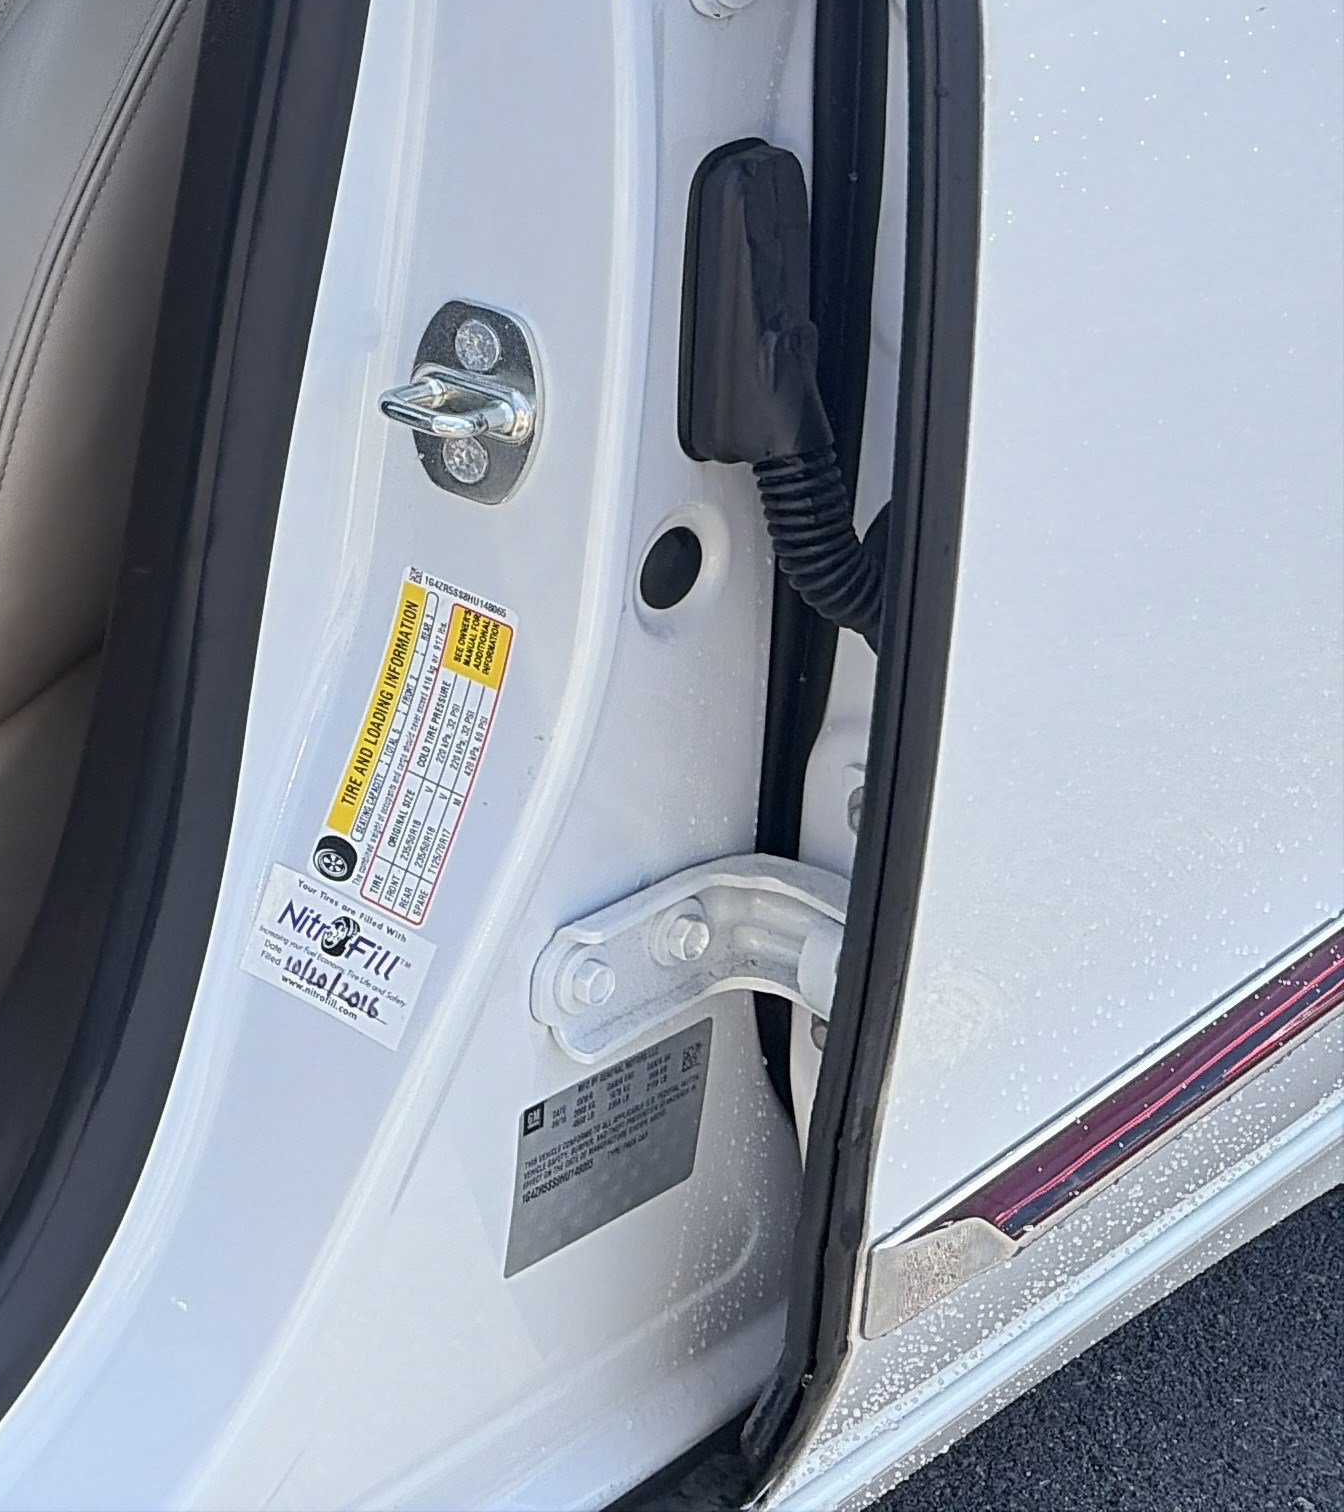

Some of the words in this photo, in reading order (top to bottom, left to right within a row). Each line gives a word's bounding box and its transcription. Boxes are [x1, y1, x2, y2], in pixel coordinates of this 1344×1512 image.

[463, 632, 476, 666] MANUAL
[471, 612, 481, 631] FOR
[473, 618, 490, 670] ADDITIONAL
[481, 622, 499, 675] INFORMATION
[453, 645, 463, 662] SEE
[340, 774, 362, 808] TIRE
[352, 745, 374, 777] AND
[363, 688, 393, 745] LOADING
[383, 599, 419, 688] INFORMATION
[430, 679, 451, 724] PRESSURE
[449, 702, 460, 717] PSI
[446, 717, 456, 729] 32
[460, 724, 470, 736] 32
[464, 709, 475, 724] PSI
[423, 724, 438, 744] TIRE
[416, 745, 431, 767] COLD
[355, 804, 372, 834] SEATING
[366, 772, 384, 806] CAPACITY
[401, 788, 415, 809] SIZE
[424, 785, 434, 794] V
[387, 807, 408, 849] ORIGINAL
[412, 889, 428, 916] SPARE
[427, 828, 451, 874] T125/70R17
[478, 715, 488, 730] PSI
[399, 817, 421, 861] 235/50R18
[369, 872, 383, 896] TIRE
[384, 873, 400, 903] FRONT
[399, 885, 413, 910] REAR
[296, 878, 317, 895] Your
[318, 890, 339, 907] Tires
[341, 904, 356, 916] are
[358, 911, 383, 930] Filled
[385, 926, 407, 943] With
[260, 949, 281, 966] Filled
[263, 939, 282, 954] Date
[258, 923, 289, 945] Increasing
[288, 940, 302, 953] your
[303, 946, 317, 958] Fuel
[346, 969, 359, 981] Tire
[359, 976, 372, 988] Life
[371, 983, 385, 996] and
[384, 991, 407, 1009] Safety
[280, 972, 358, 1021] www.nitrofill.com
